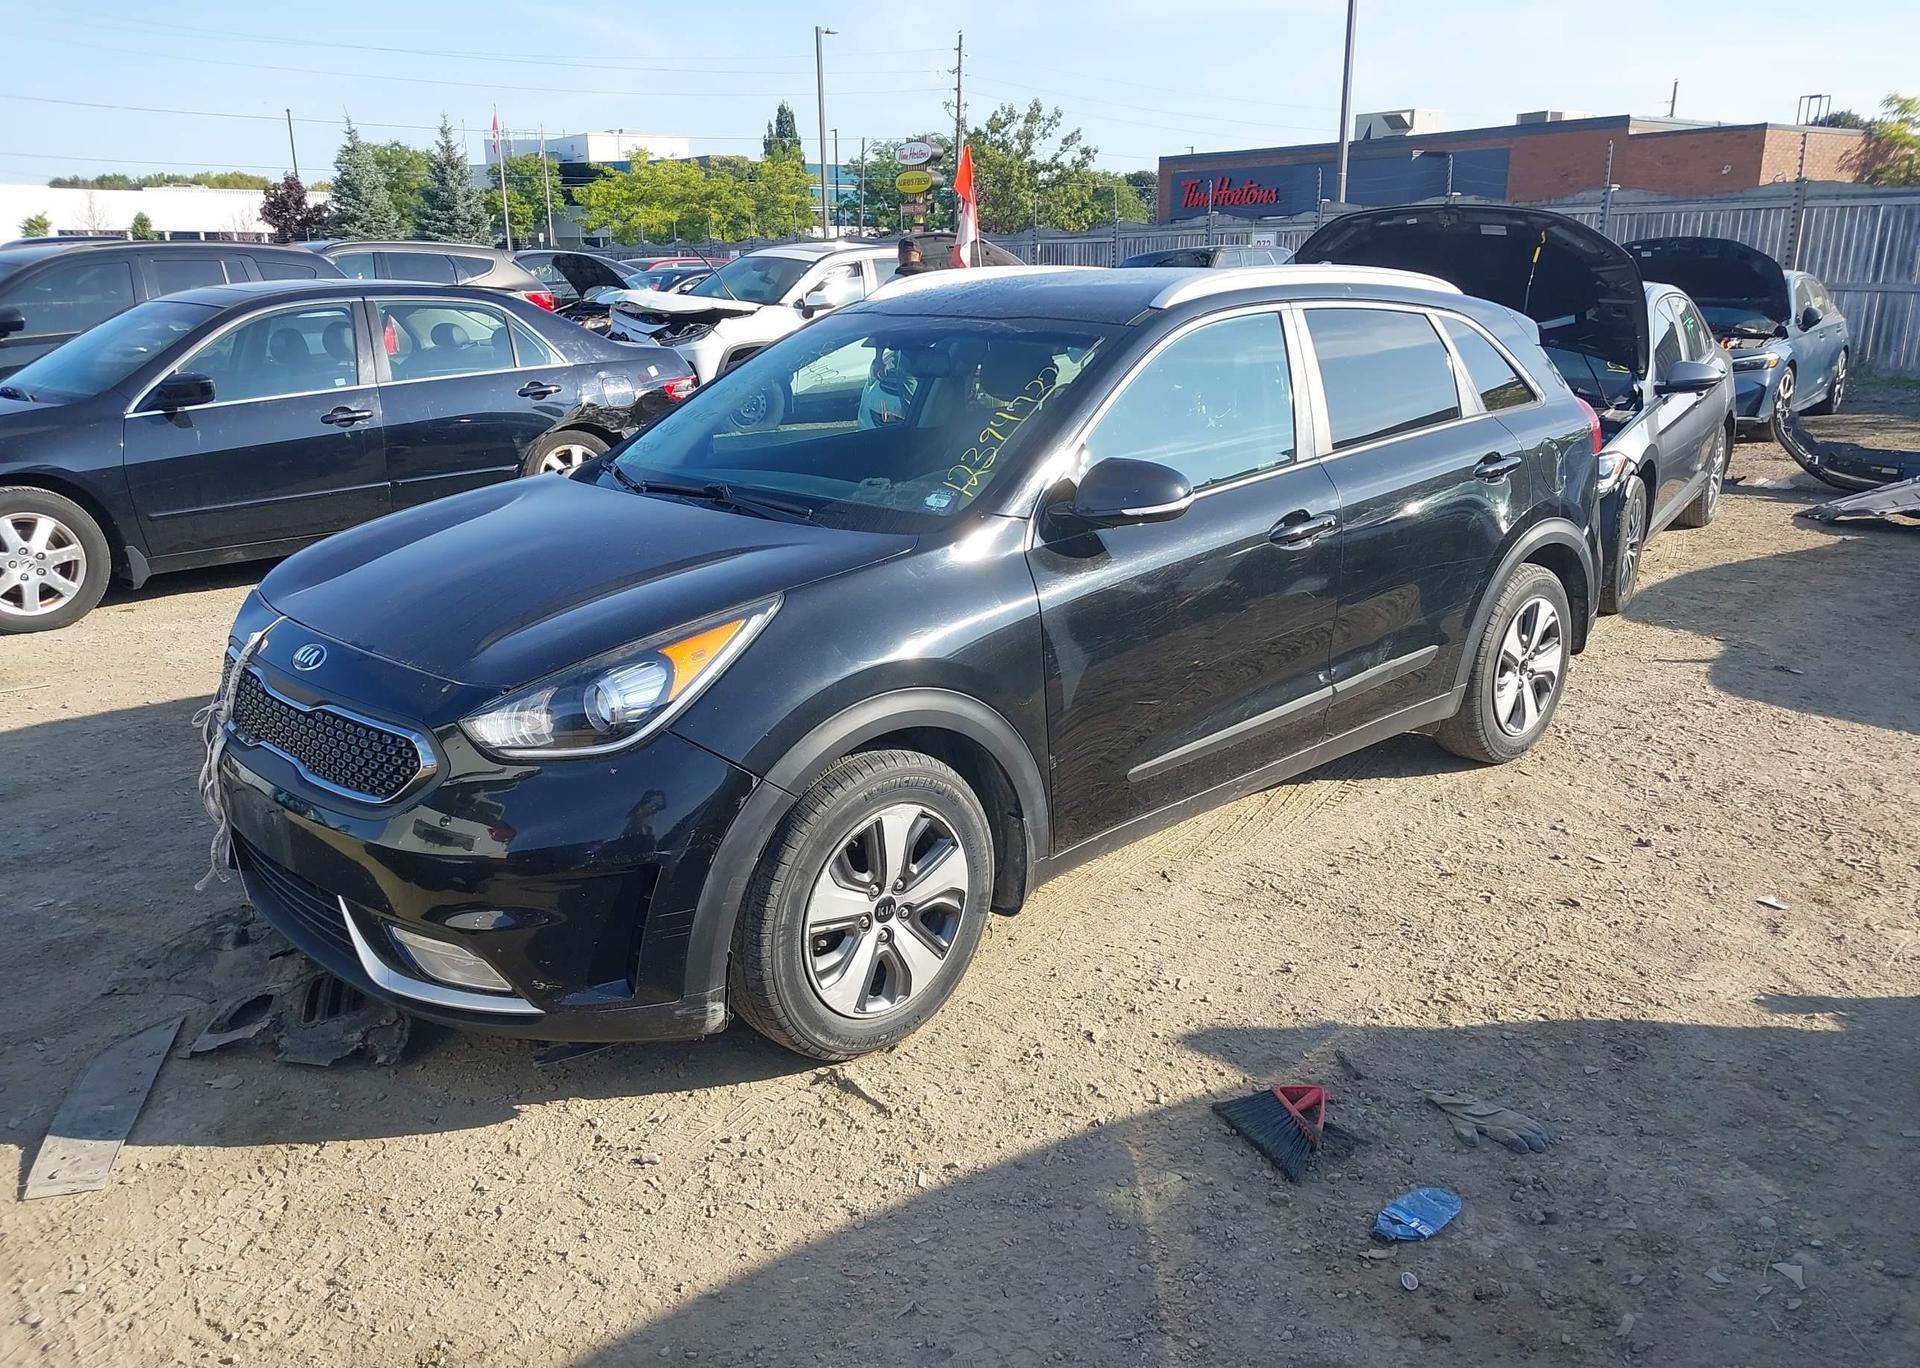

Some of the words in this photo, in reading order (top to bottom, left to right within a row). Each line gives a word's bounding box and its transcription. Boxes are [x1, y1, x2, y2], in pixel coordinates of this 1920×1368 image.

[1182, 178, 1210, 208] Tim
[1212, 176, 1278, 206] Hortons
[294, 645, 321, 667] KIA
[877, 904, 895, 917] KIA
